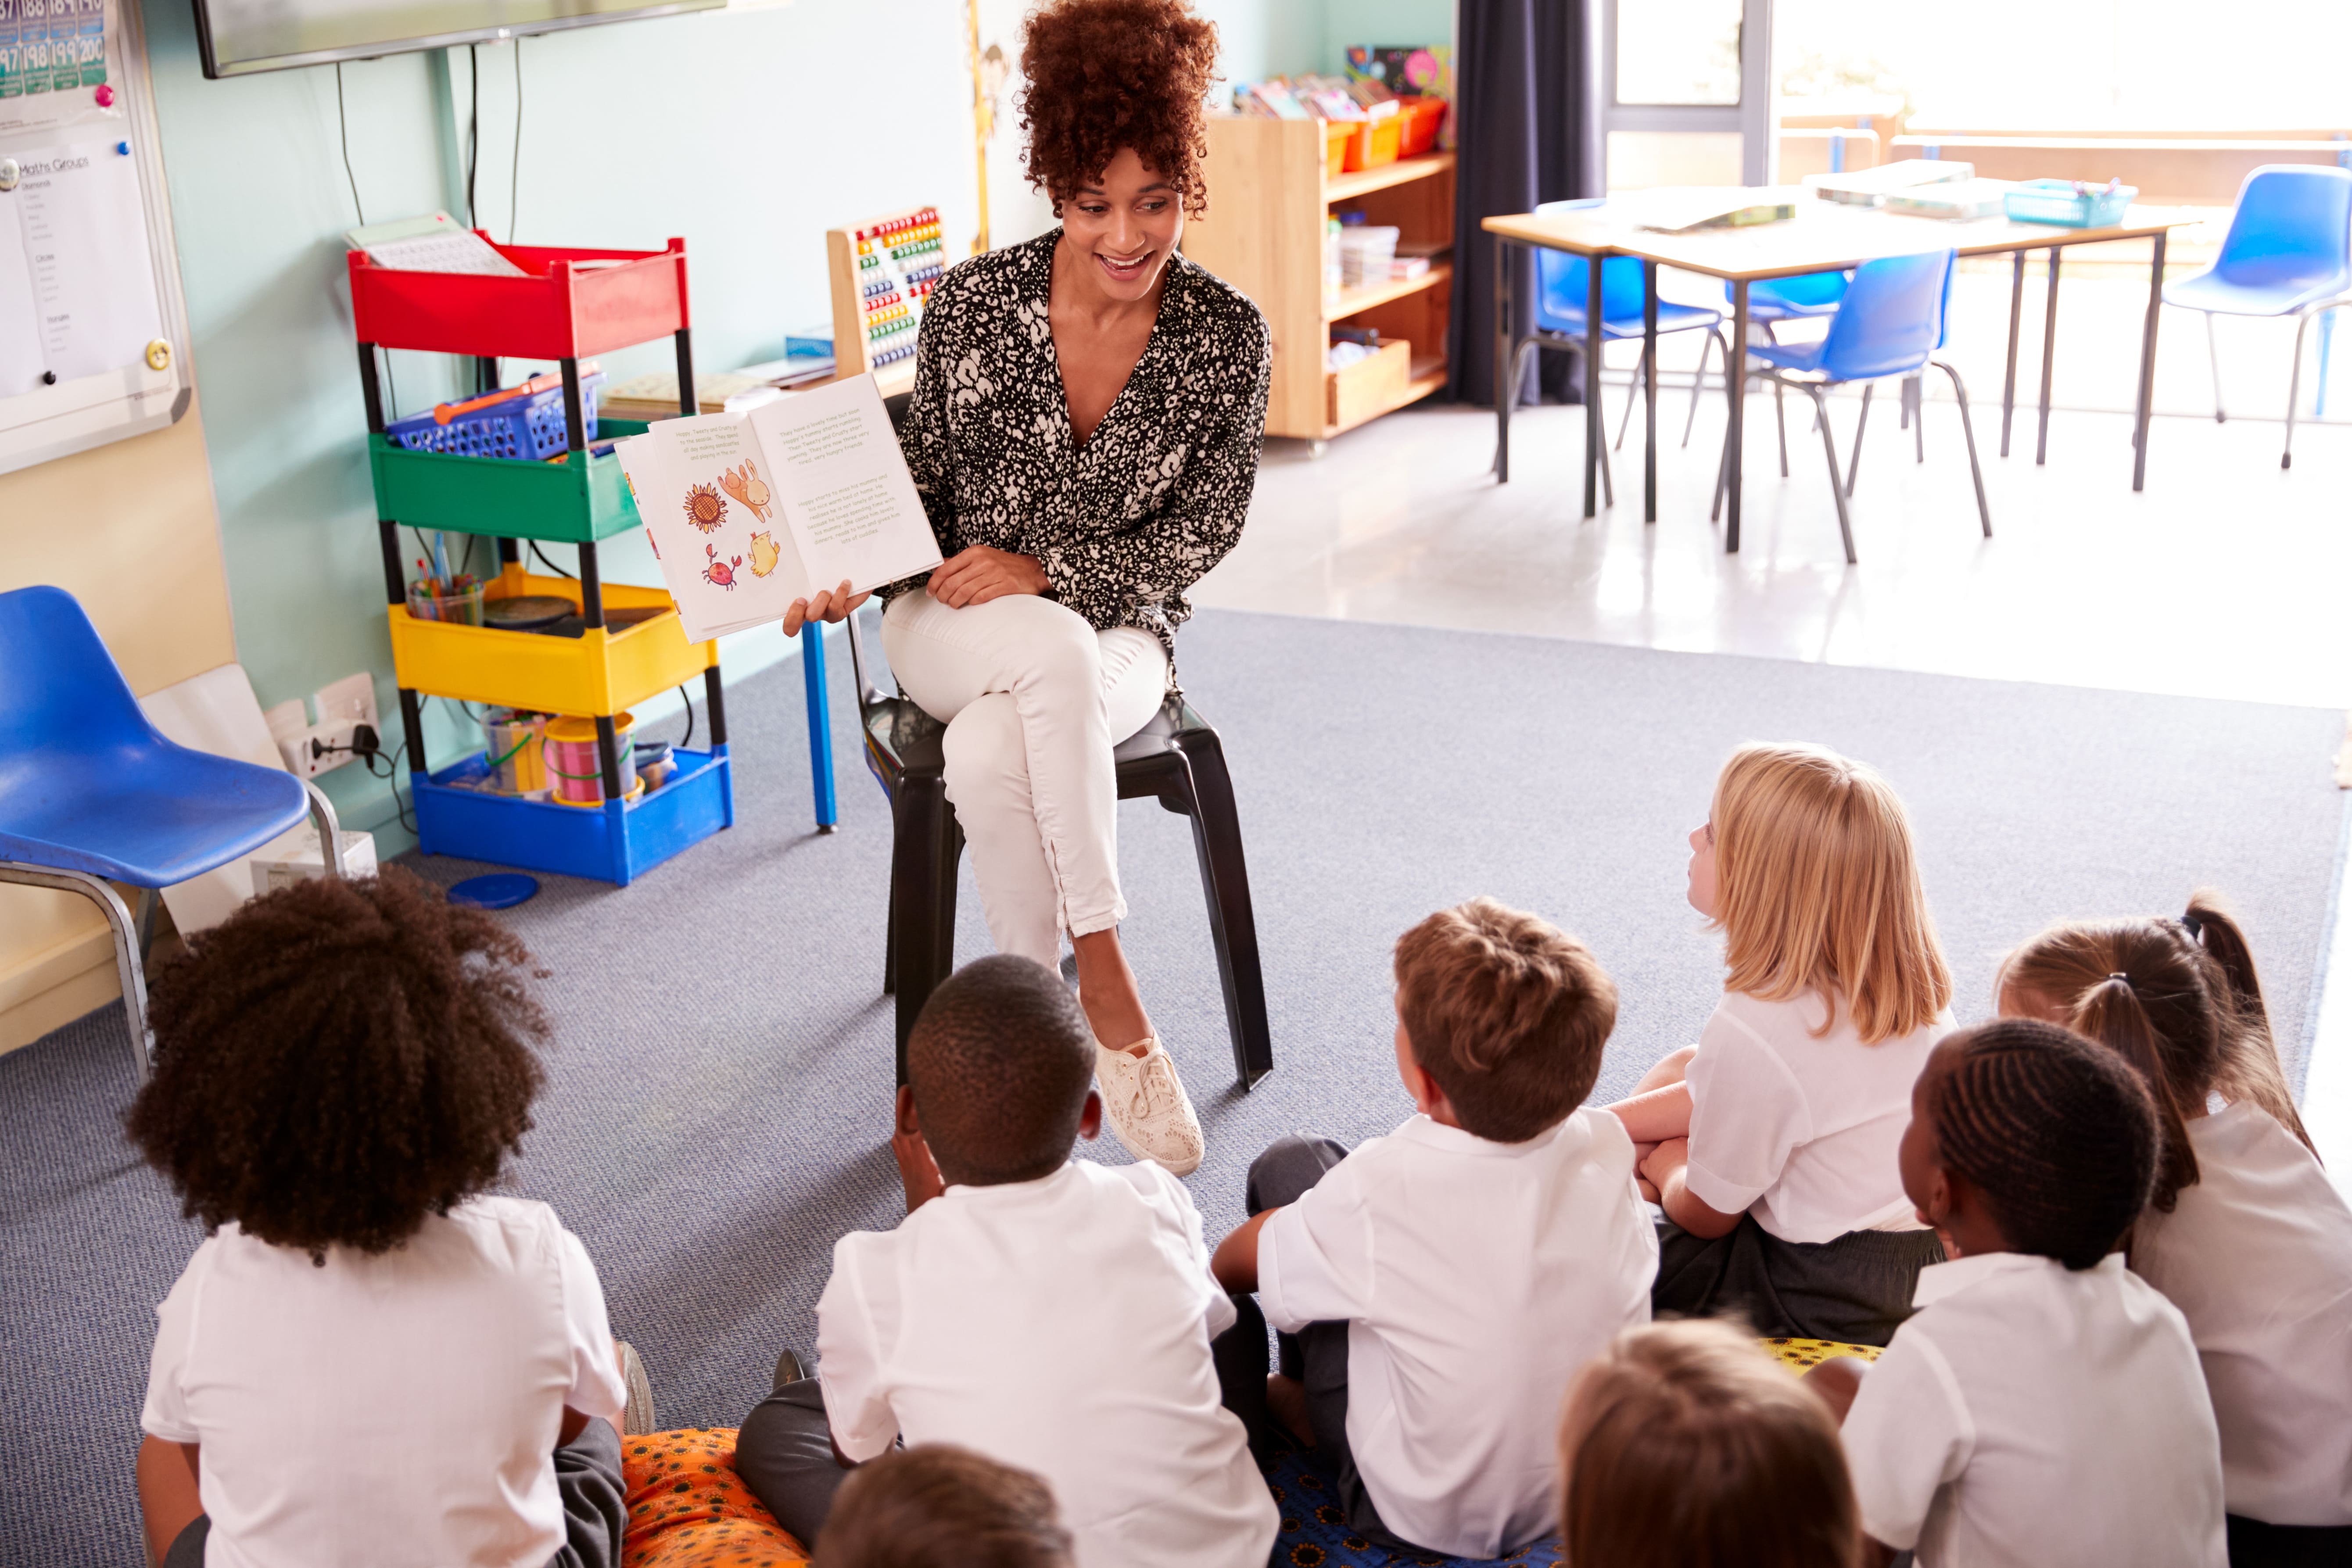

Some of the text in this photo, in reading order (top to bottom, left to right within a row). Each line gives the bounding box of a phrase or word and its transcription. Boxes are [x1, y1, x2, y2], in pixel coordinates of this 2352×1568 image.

[21, 0, 44, 18] 188
[23, 44, 47, 70] 198
[51, 39, 77, 65] 199
[79, 36, 104, 62] 200
[19, 161, 50, 177] Maths
[53, 156, 89, 172] Groups
[805, 429, 822, 437] tummy
[822, 424, 839, 432] starts
[839, 416, 862, 426] rumbling.
[802, 438, 821, 447] Tweety
[826, 448, 843, 456] hungry
[815, 493, 831, 501] starts
[859, 478, 877, 487] mummy
[807, 520, 828, 530] because
[850, 506, 872, 516] spending
[809, 511, 829, 520] realises
[814, 535, 835, 545] dinners,
[877, 516, 890, 524] gives
